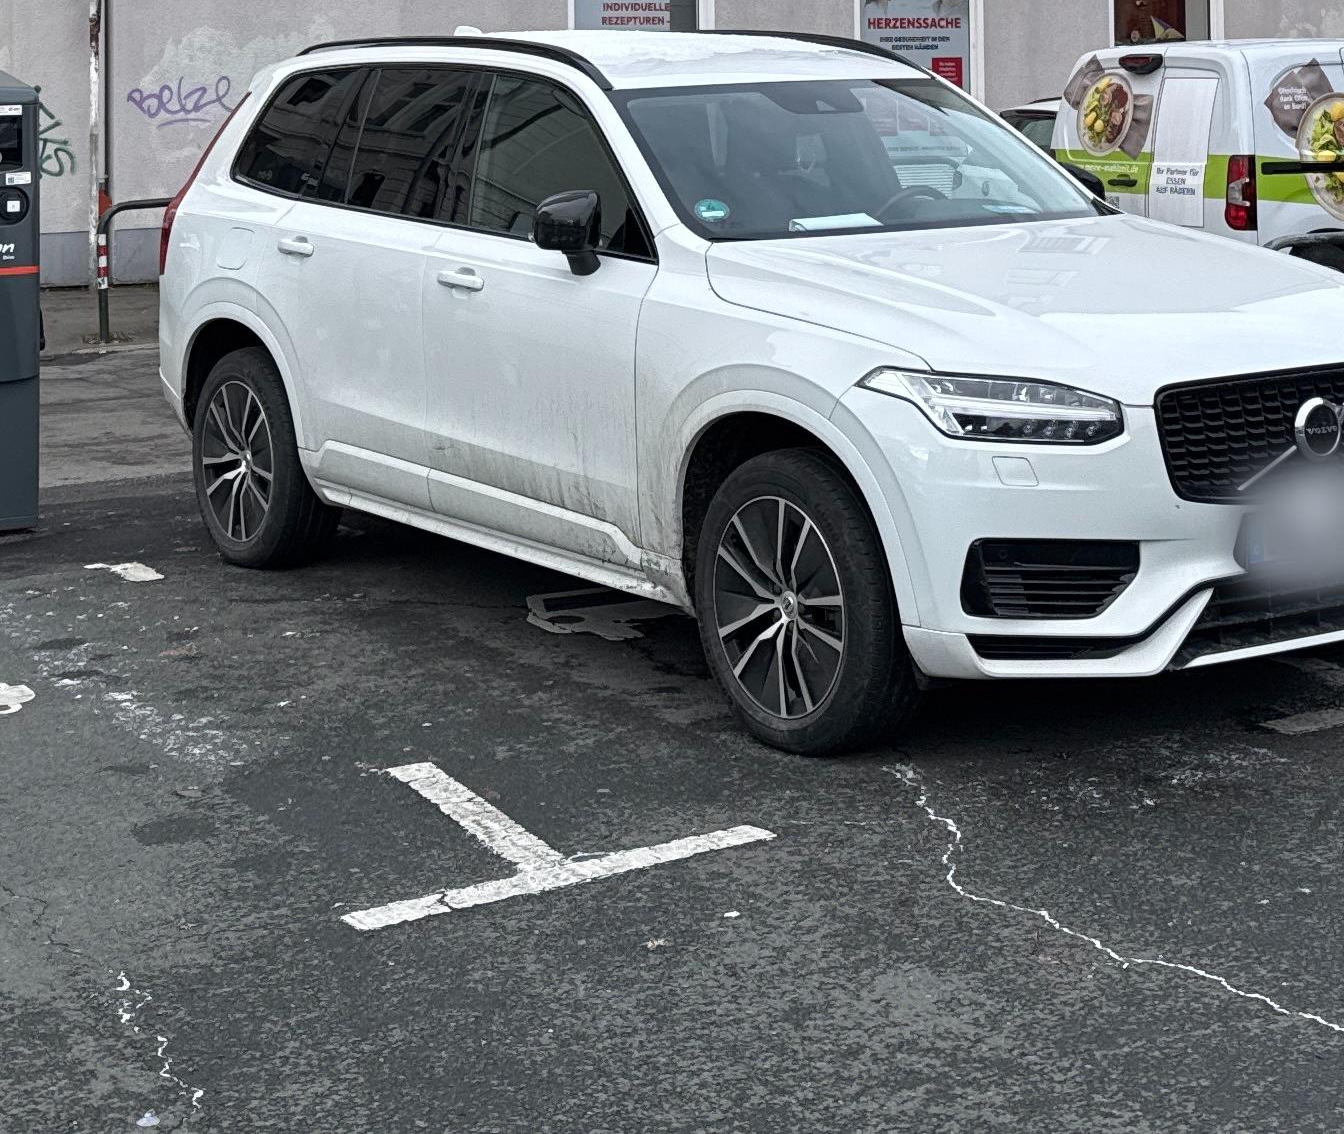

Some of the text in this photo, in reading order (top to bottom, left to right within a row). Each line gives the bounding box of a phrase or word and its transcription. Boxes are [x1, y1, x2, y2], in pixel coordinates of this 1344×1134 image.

[603, 3, 670, 11] INDIVIDUELLE
[602, 16, 664, 25] REZEPTUREN
[867, 17, 961, 29] HERZENSSACHE
[1166, 177, 1186, 185] ESSEN
[1306, 425, 1338, 435] VOLVO
